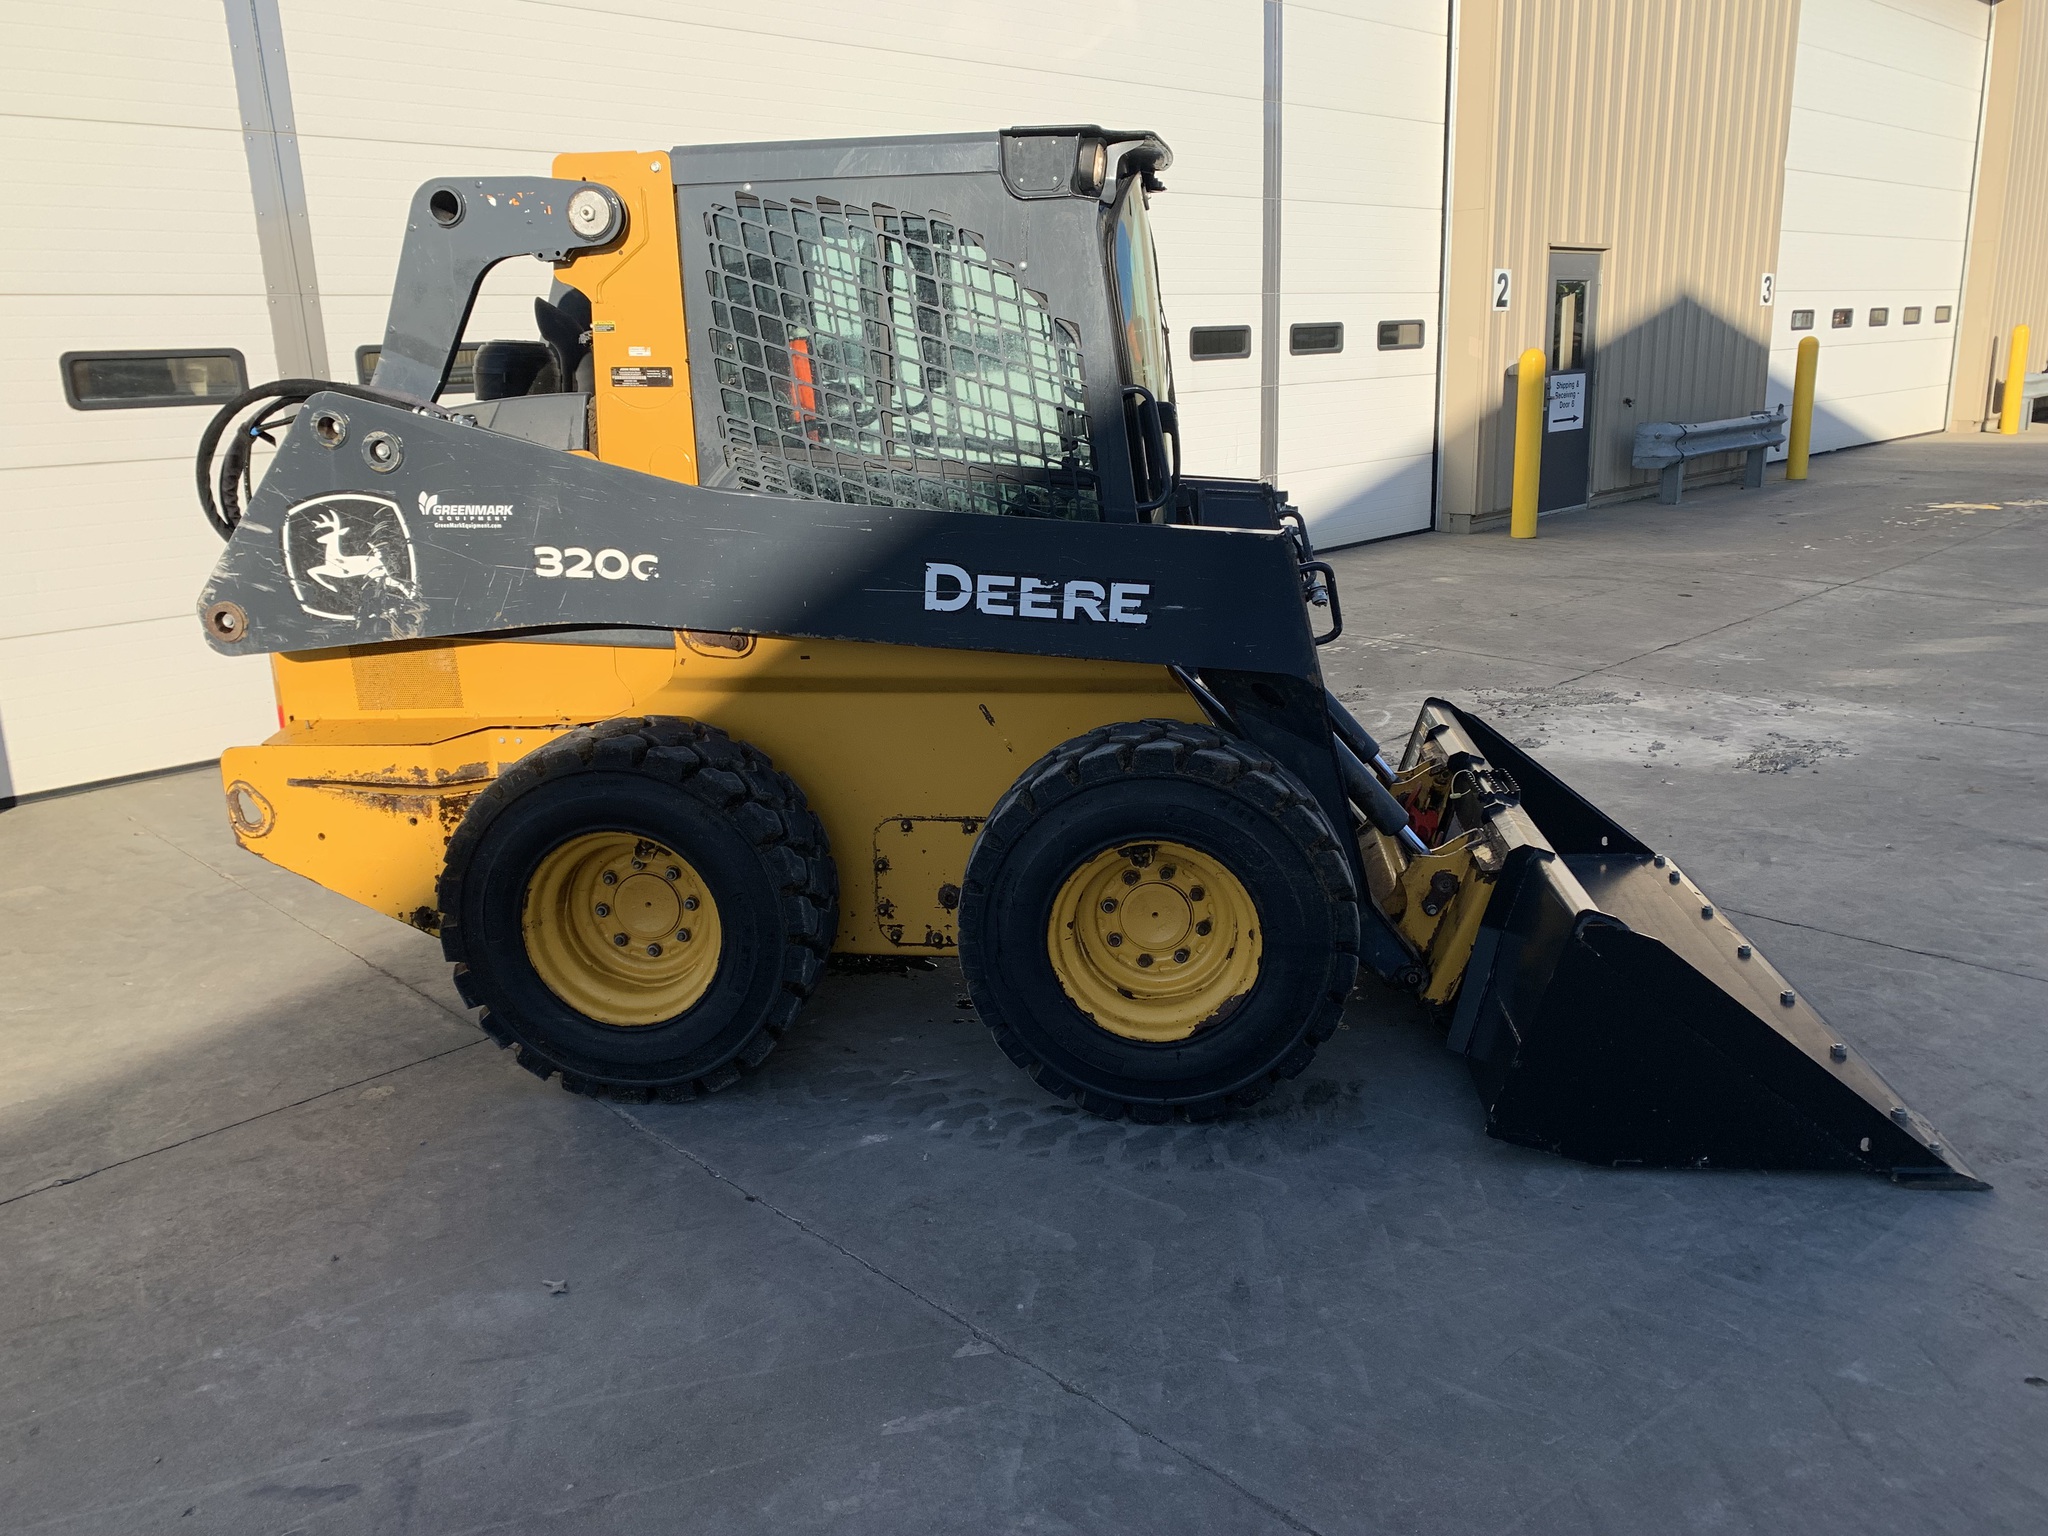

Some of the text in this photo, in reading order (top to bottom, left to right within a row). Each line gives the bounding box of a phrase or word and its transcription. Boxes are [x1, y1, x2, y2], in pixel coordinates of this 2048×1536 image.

[1496, 272, 1509, 307] 2
[1763, 275, 1772, 303] 3
[1556, 381, 1575, 390] Shipping
[1559, 400, 1570, 409] Door
[432, 504, 514, 516] GREENMARK
[924, 562, 1150, 624] DEERE
